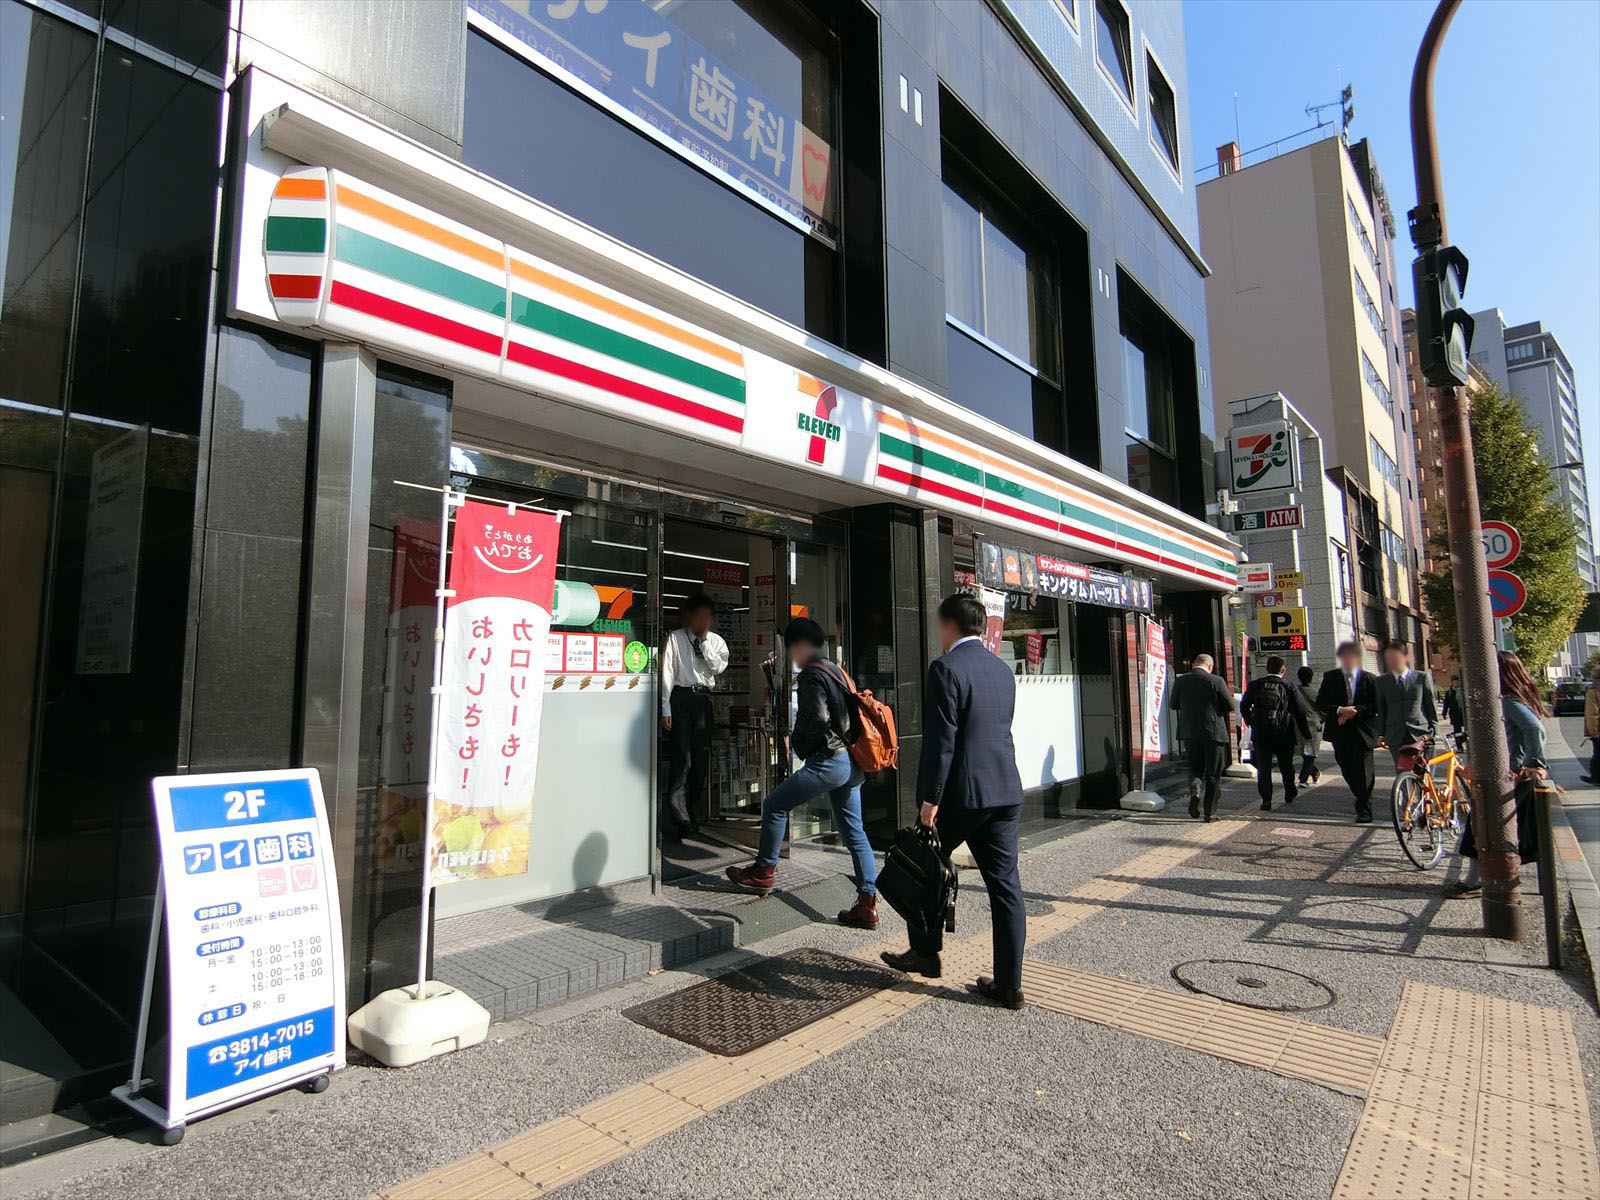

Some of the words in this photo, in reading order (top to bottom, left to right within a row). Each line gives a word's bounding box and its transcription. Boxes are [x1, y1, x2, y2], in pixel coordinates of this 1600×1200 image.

[1241, 513, 1258, 530] 酒
[1269, 508, 1297, 528] ATM
[1271, 612, 1292, 634] P
[223, 789, 266, 821] 2F
[185, 833, 314, 872] アイ歯科
[200, 937, 241, 955] 受付時間
[234, 1044, 292, 1076] アイ歯科
